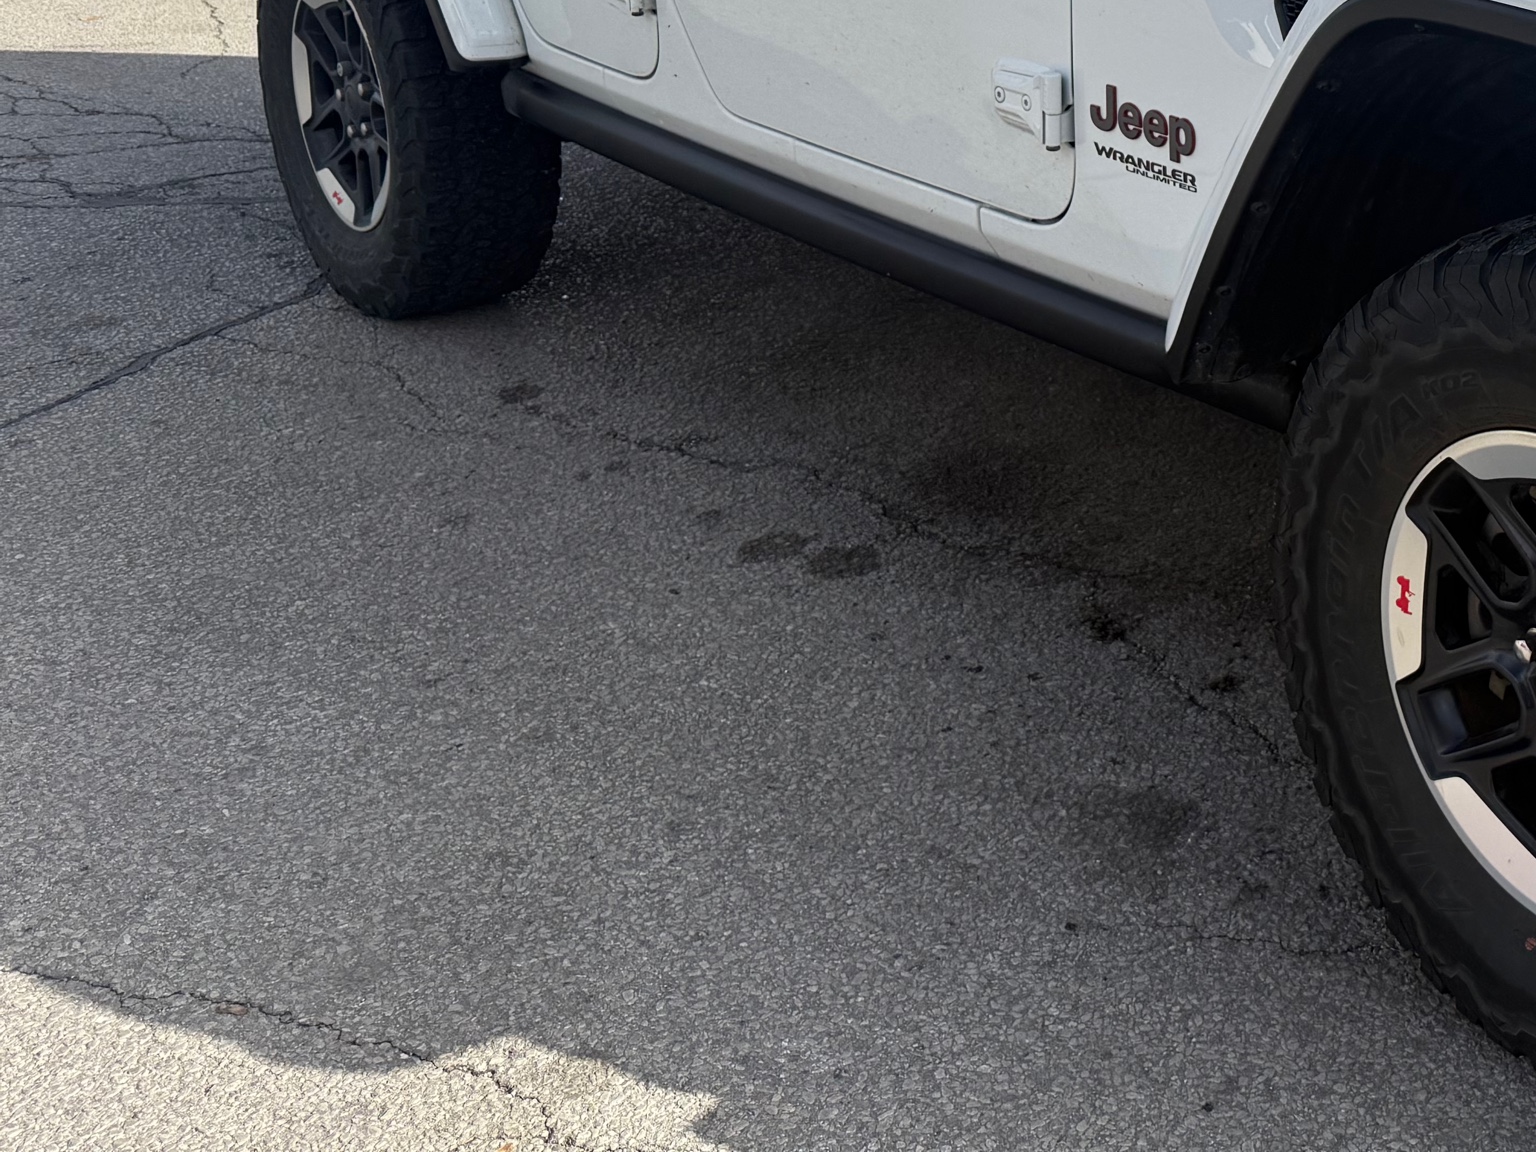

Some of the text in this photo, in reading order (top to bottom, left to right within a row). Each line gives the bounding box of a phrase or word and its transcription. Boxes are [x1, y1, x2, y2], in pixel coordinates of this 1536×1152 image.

[1090, 84, 1196, 163] Jeep
[1094, 141, 1197, 187] WRANGLER
[1126, 165, 1197, 193] UNLIMITED
